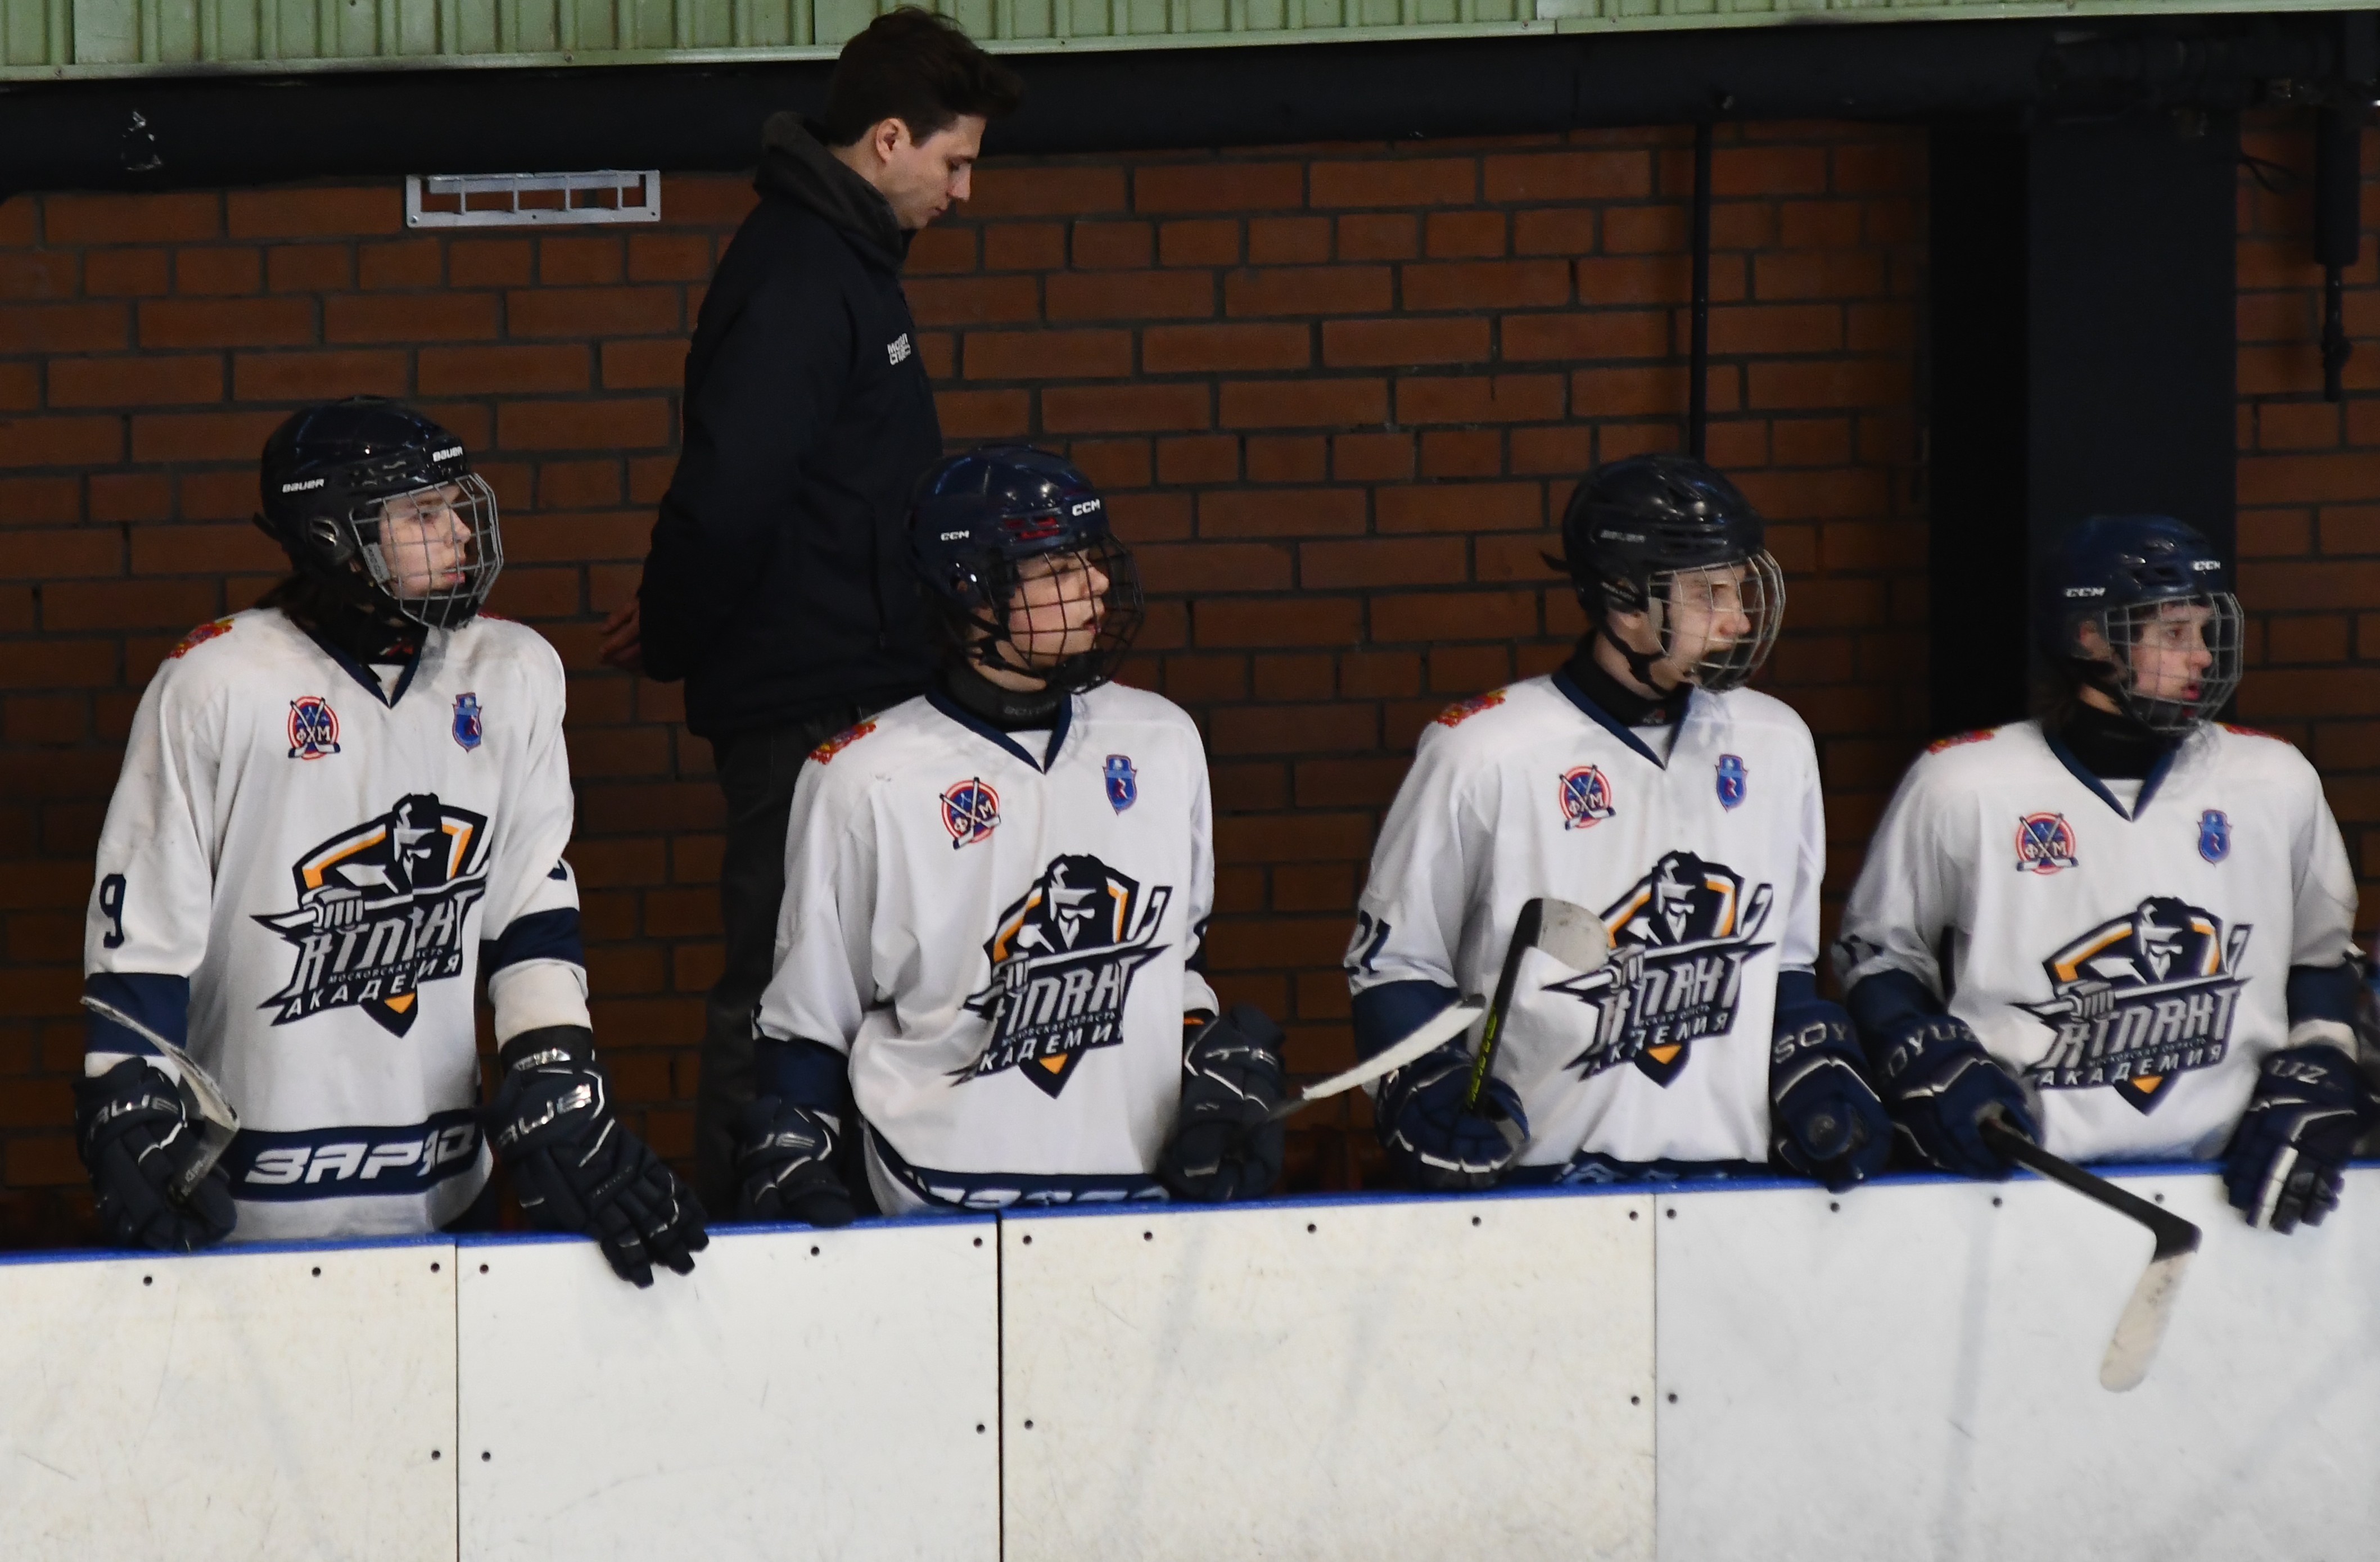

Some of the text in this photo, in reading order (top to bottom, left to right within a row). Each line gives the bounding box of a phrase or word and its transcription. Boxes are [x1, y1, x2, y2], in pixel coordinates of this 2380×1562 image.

[433, 447, 463, 462] BAUER
[282, 478, 325, 493] BAUER
[1072, 499, 1100, 517] CCM
[940, 530, 969, 541] CCM
[2194, 560, 2221, 571] CCM
[2066, 587, 2106, 597] CCM
[99, 873, 127, 949] 9
